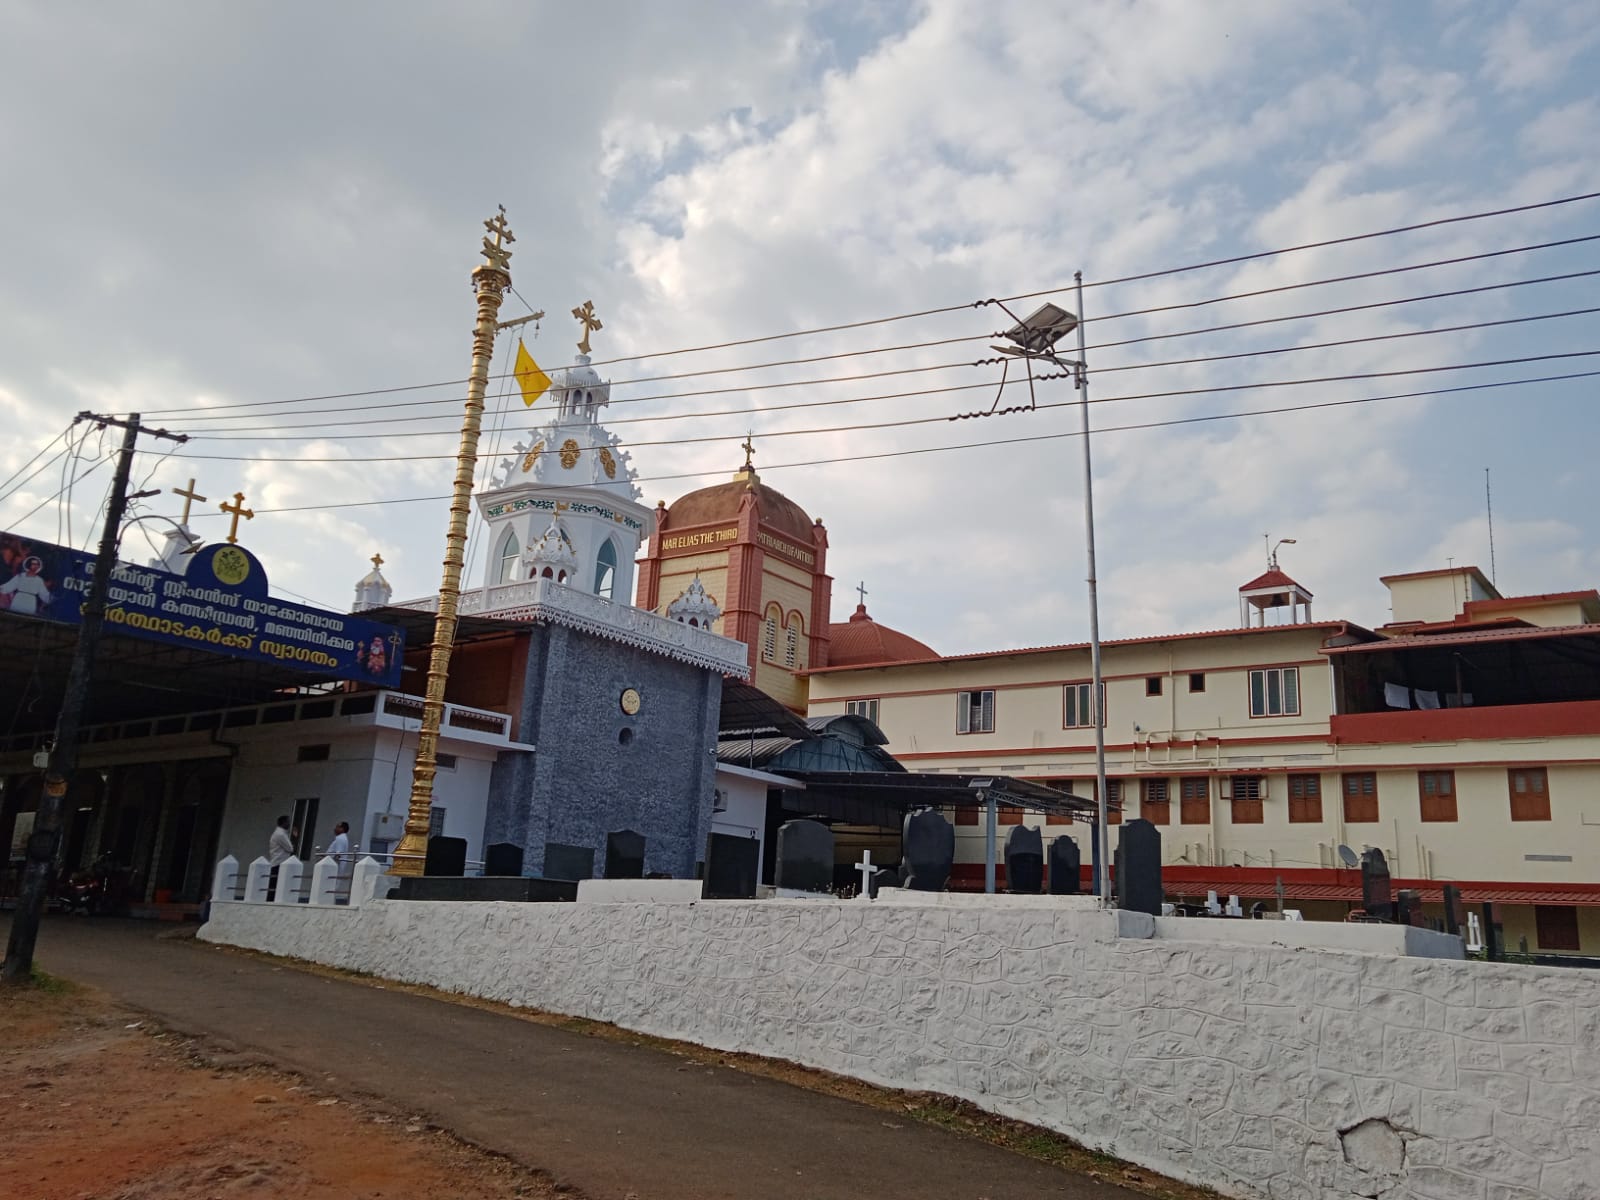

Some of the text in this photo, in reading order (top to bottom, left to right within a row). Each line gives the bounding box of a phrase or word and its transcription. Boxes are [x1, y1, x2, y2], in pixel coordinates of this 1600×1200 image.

[662, 528, 738, 550] MAR ELIAS THE THIRD
[63, 576, 156, 608] സുയാനി
[264, 622, 355, 651] മഞ്ഞിനിക്കര
[243, 599, 344, 632] യാക്കോബായ
[259, 640, 338, 668] സ്വാഗതം
